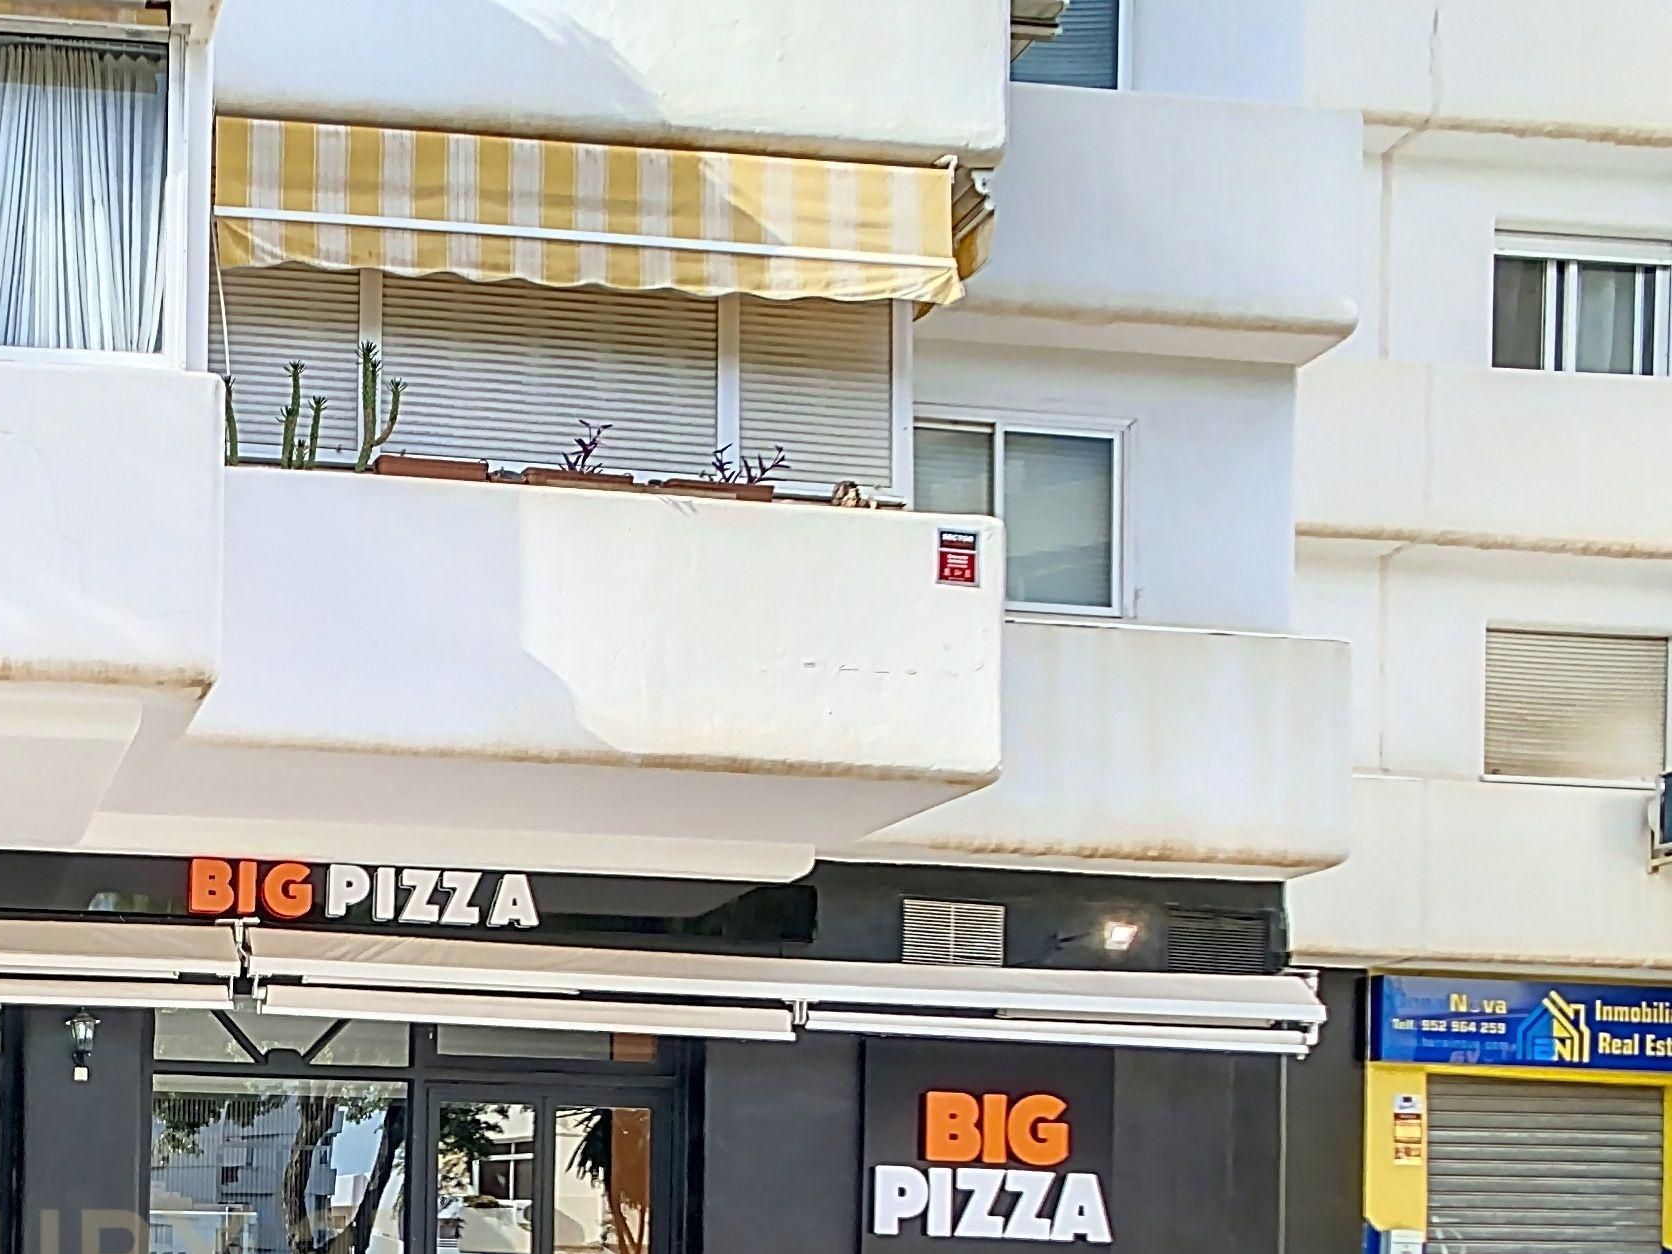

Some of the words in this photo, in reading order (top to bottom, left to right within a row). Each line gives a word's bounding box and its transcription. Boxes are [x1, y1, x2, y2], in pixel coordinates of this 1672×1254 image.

[189, 858, 313, 919] BIG
[325, 863, 541, 928] PIZZA
[1449, 993, 1507, 1014] Nva
[1598, 1032, 1640, 1056] Real
[925, 1091, 1070, 1166] BIG
[874, 1165, 1113, 1243] PIZZA
